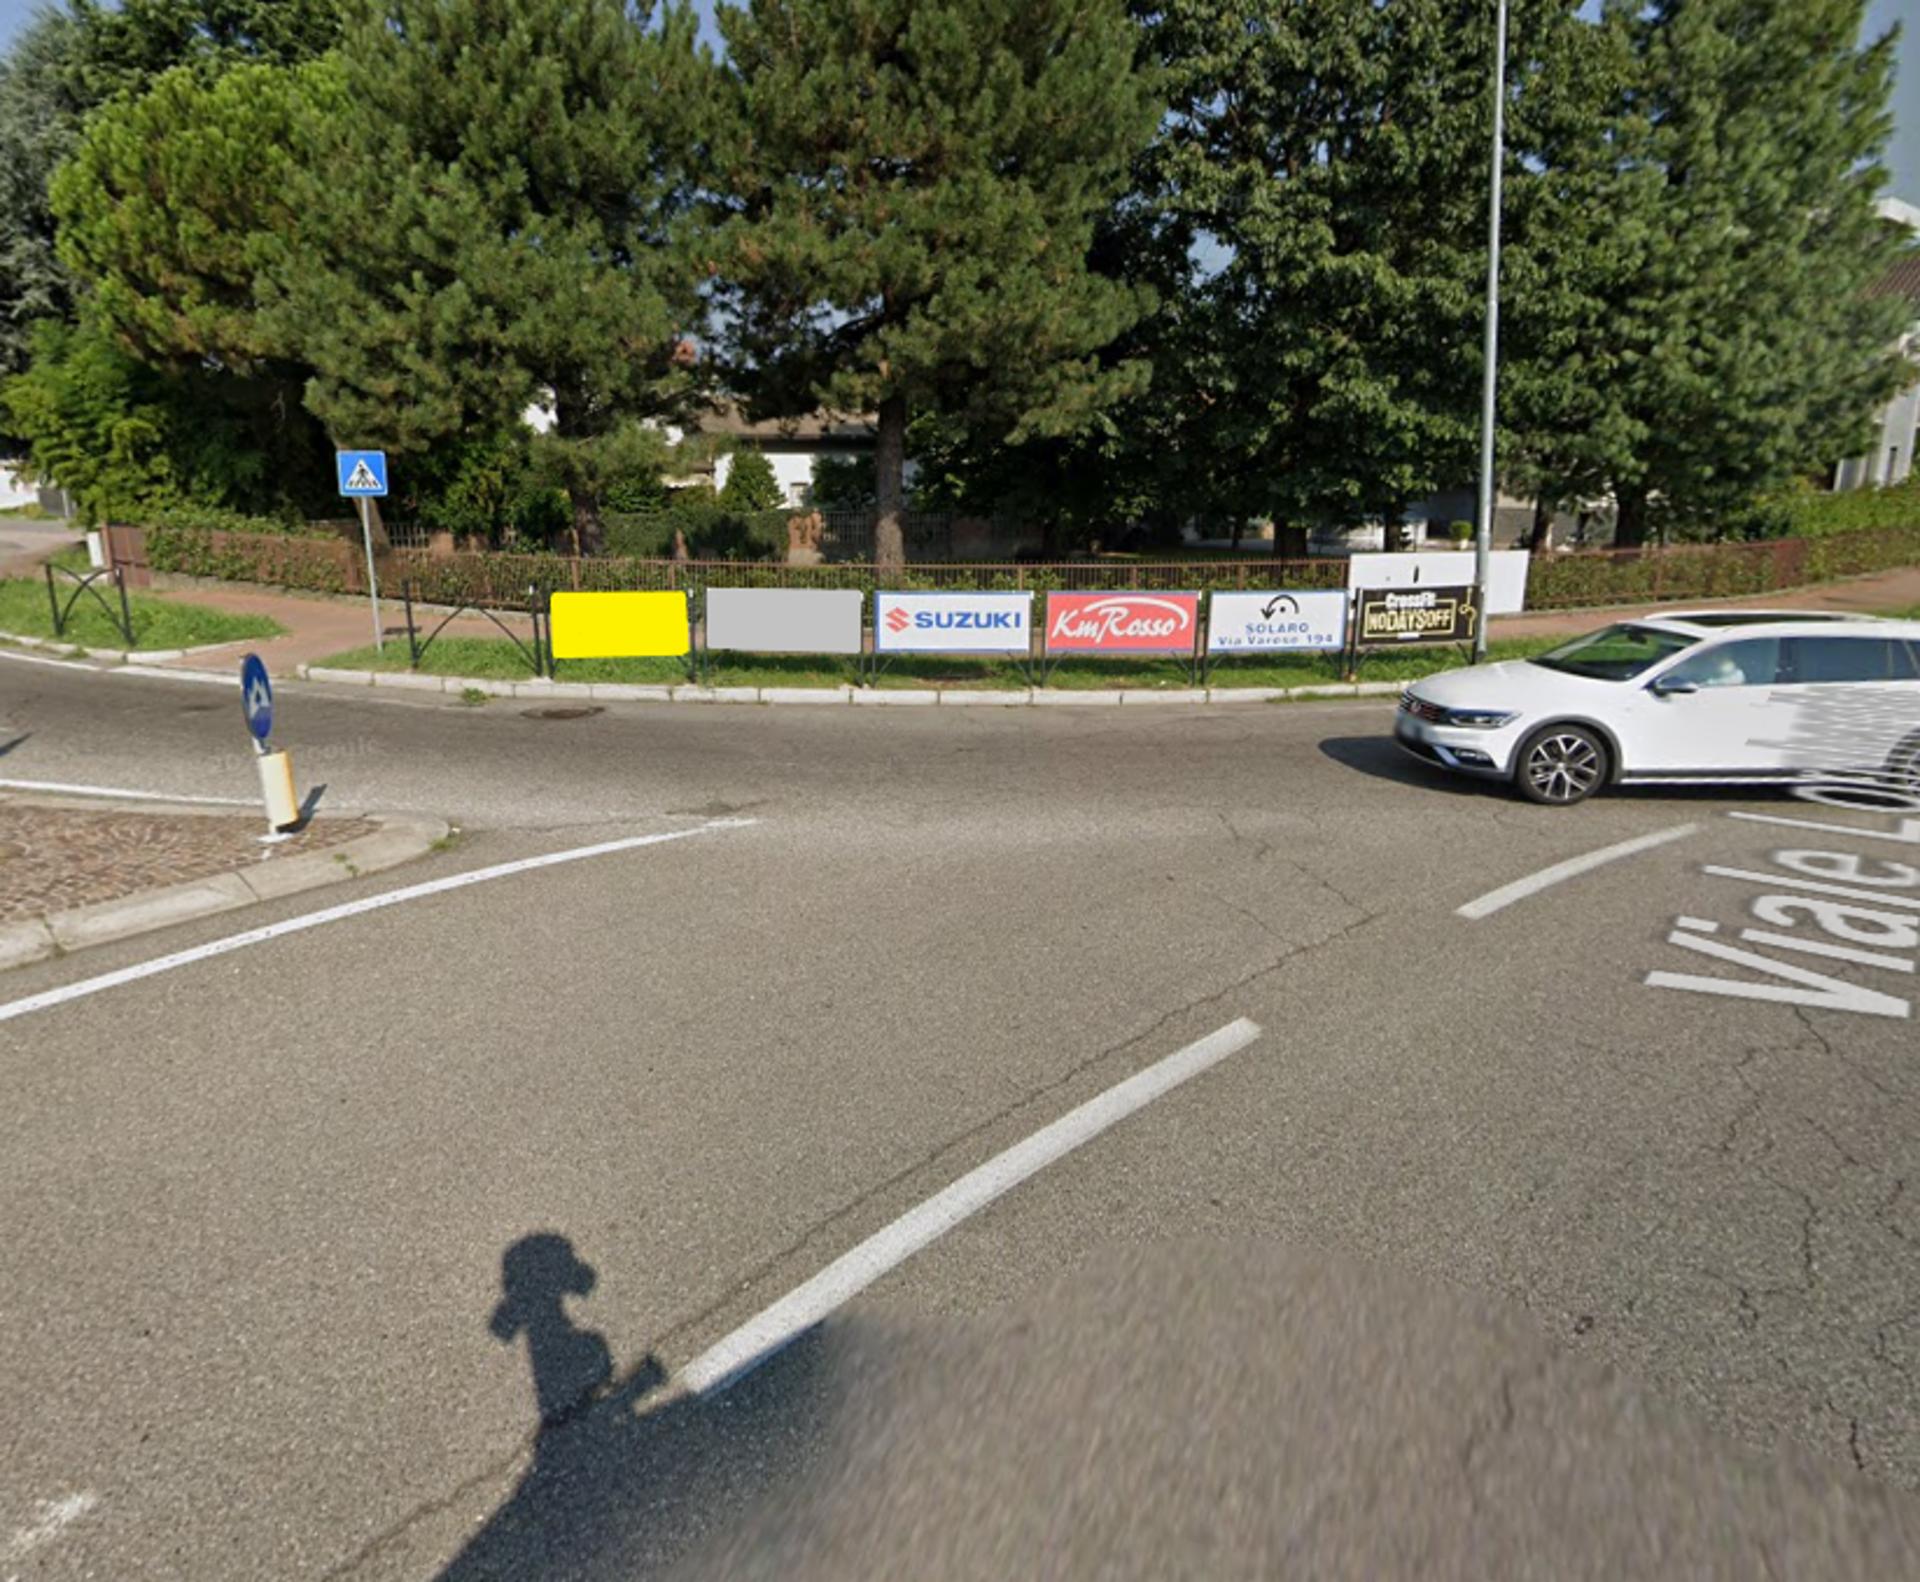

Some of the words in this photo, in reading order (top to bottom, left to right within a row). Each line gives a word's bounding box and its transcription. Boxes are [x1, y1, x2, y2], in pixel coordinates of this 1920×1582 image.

[915, 611, 1021, 629] SUZUKI
[1246, 622, 1309, 633] SOLARO
[1218, 636, 1241, 645] Via
[1307, 634, 1333, 643] 194
